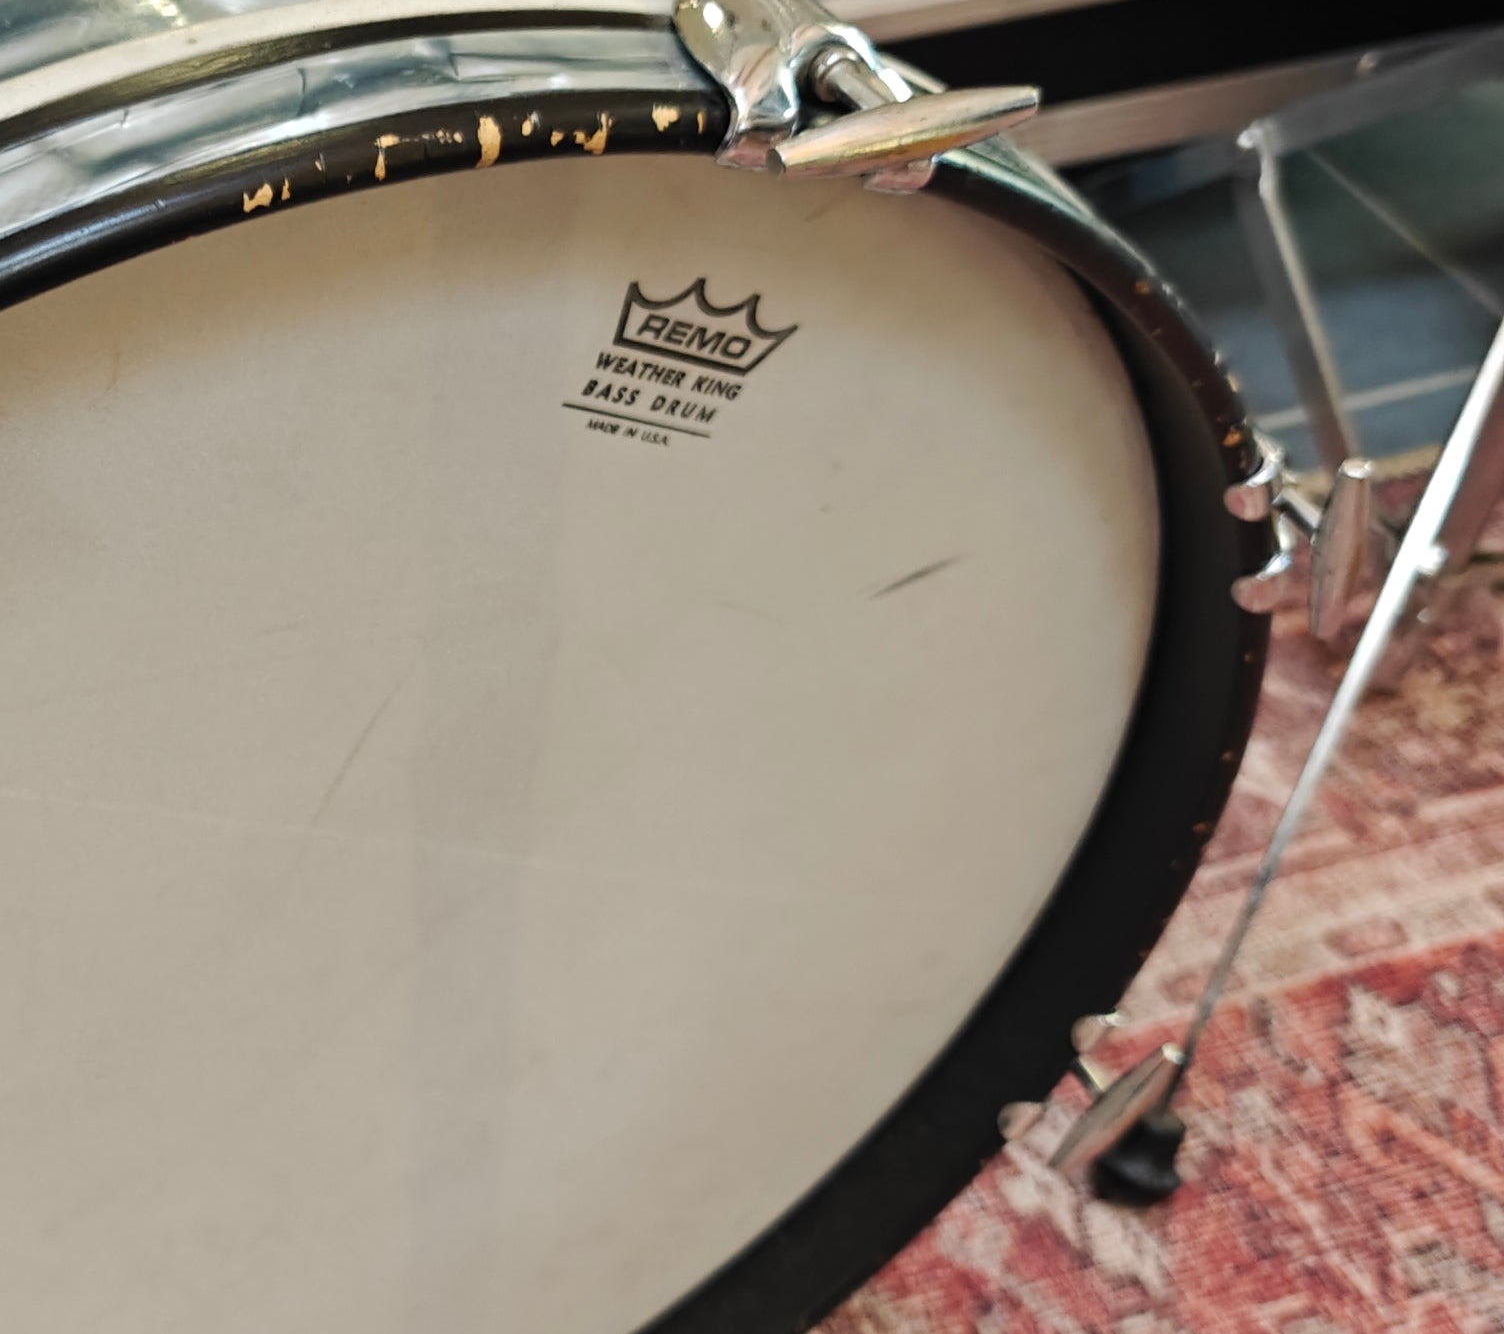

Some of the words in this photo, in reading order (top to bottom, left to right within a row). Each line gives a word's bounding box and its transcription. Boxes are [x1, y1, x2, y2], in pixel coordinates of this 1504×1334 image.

[637, 314, 751, 360] REMO
[596, 352, 686, 389] WEATHER
[691, 375, 742, 401] KING
[582, 379, 639, 406] BASS
[650, 395, 716, 424] DRUM
[586, 419, 620, 435] MADE
[623, 426, 638, 438] IN
